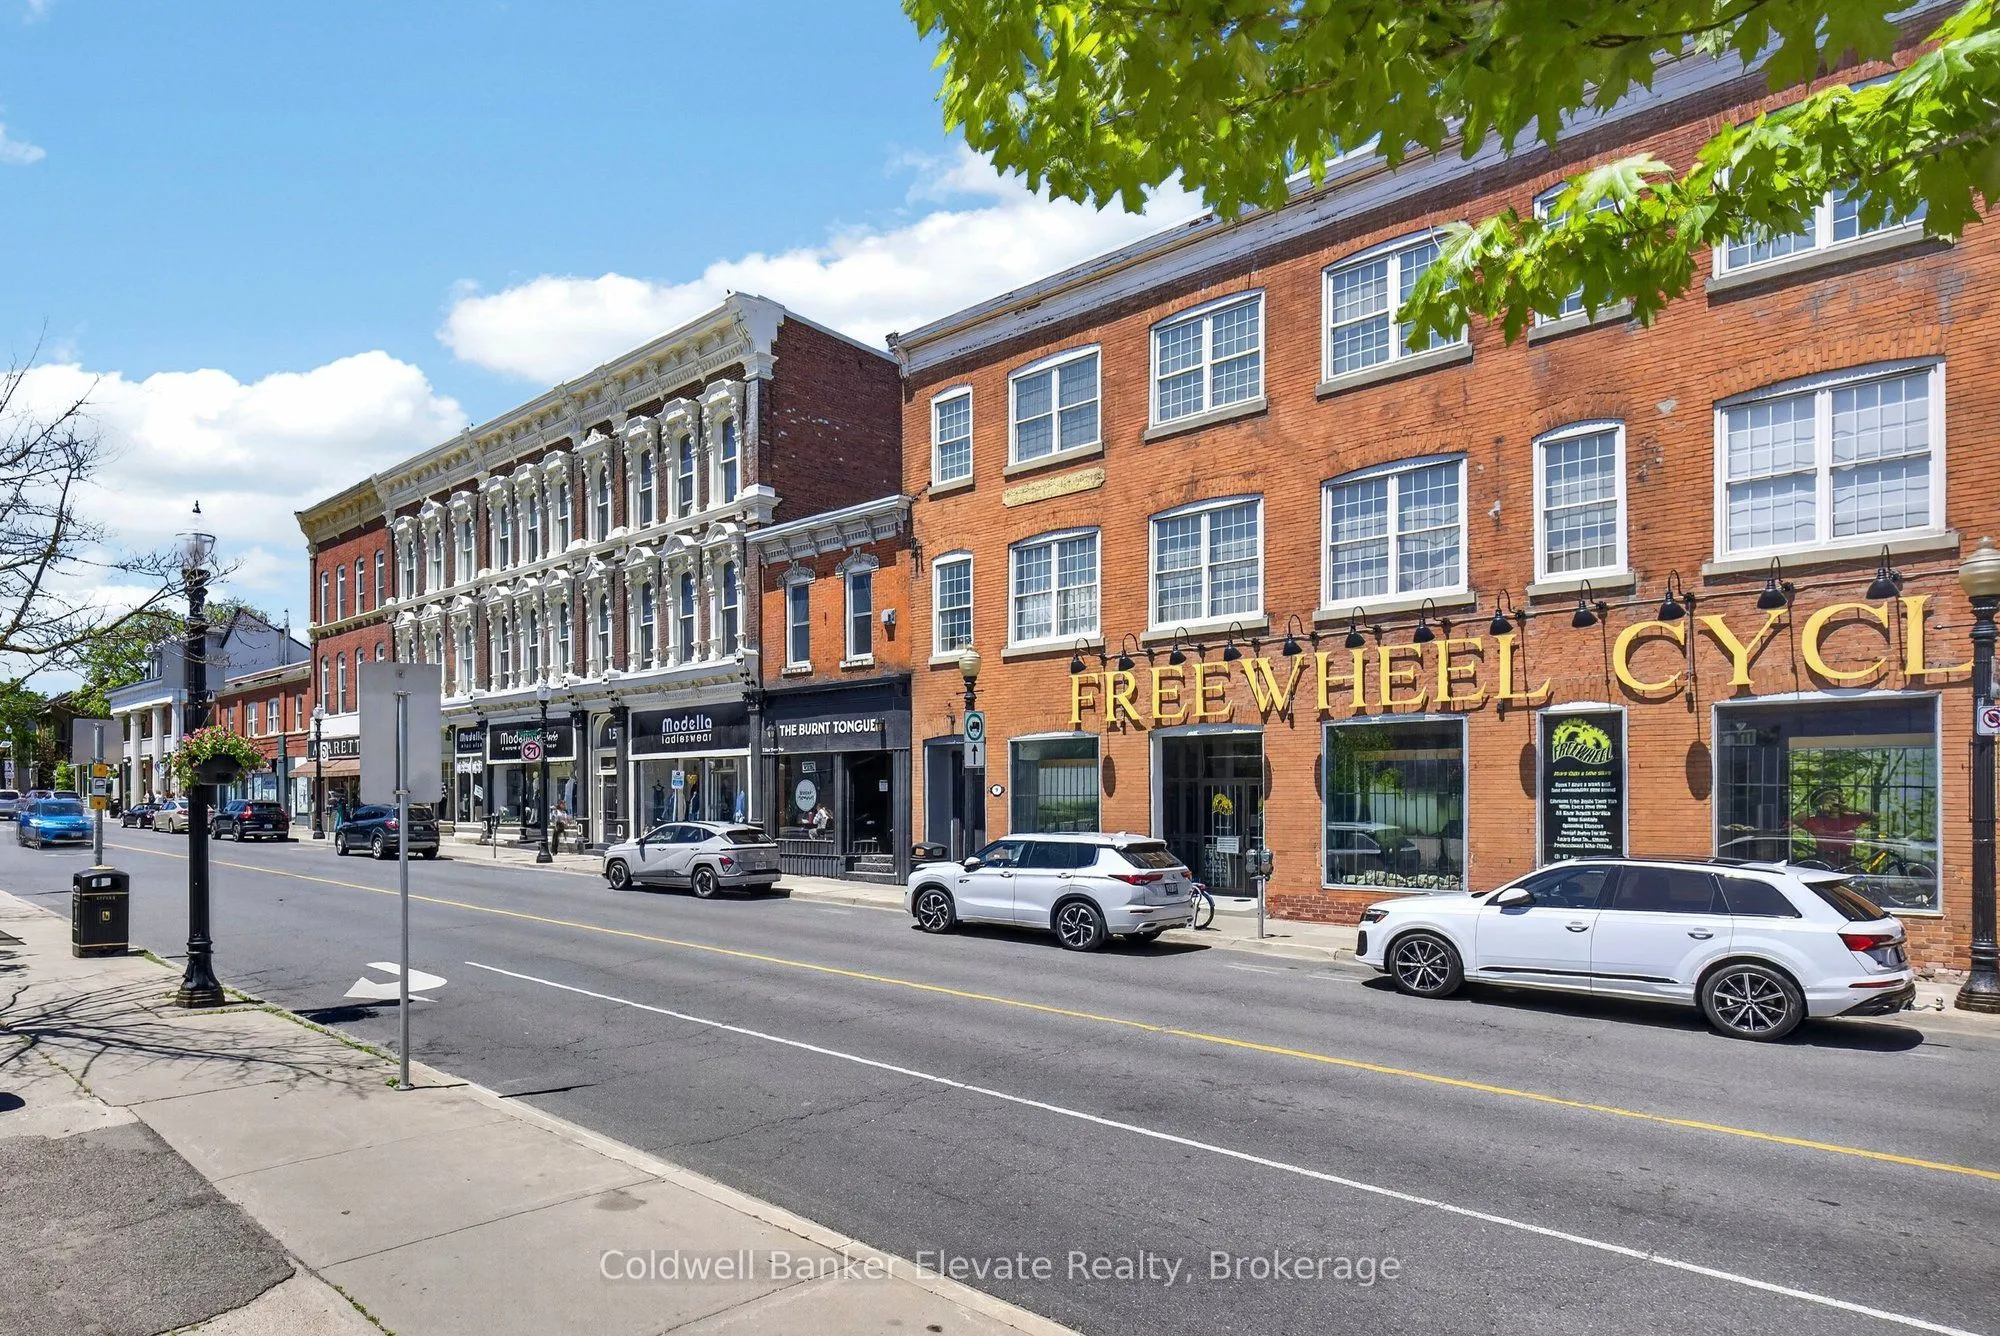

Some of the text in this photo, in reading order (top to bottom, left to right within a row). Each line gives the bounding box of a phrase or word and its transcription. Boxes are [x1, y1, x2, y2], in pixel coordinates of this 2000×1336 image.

[1068, 633, 1552, 725] FREEWHEEL
[662, 714, 712, 733] Modella
[779, 718, 876, 737] THE BURNT TONGUE
[608, 727, 618, 740] 15
[661, 733, 712, 744] ladieswear
